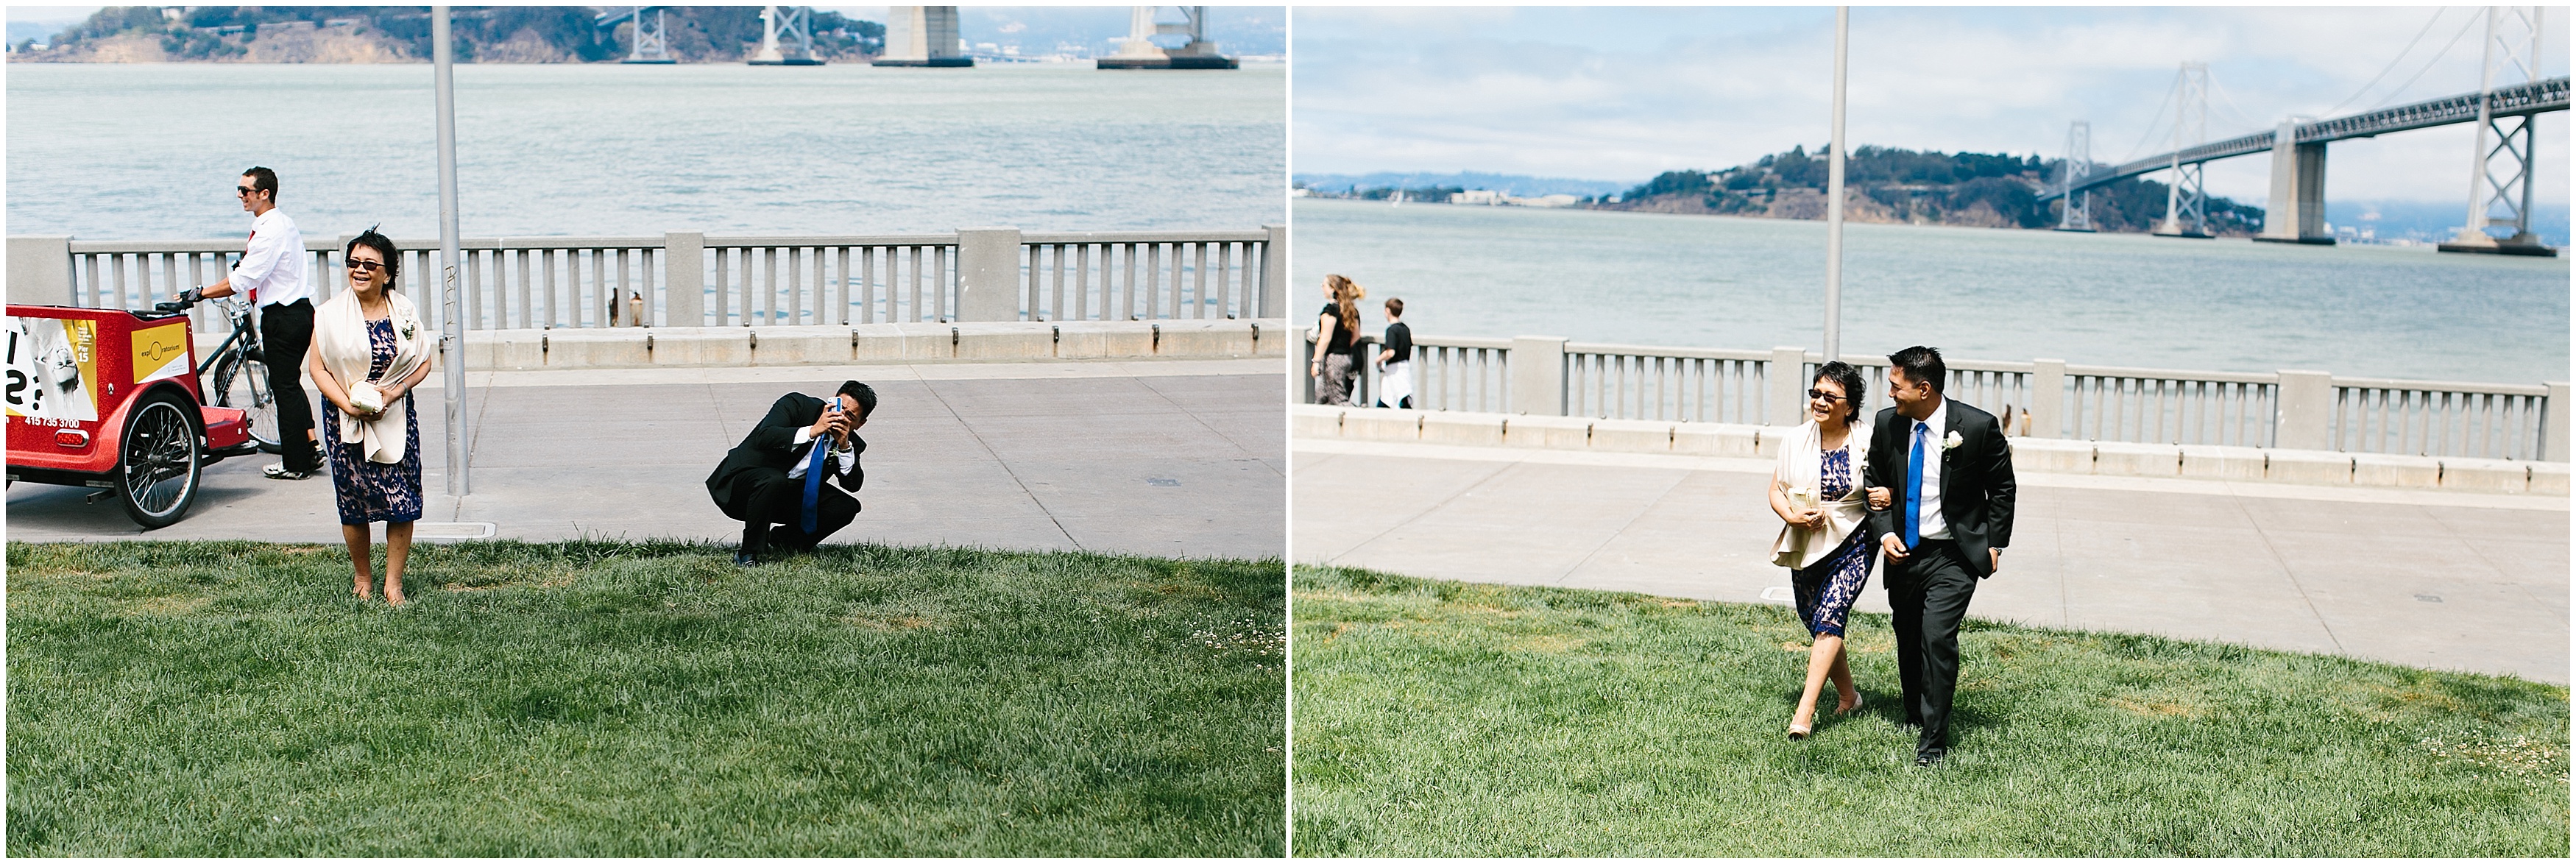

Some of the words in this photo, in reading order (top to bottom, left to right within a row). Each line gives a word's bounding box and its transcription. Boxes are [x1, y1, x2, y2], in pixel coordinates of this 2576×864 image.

[78, 352, 89, 363] 15
[25, 416, 41, 426] 415
[42, 417, 58, 427] 735
[59, 418, 79, 428] 3700
